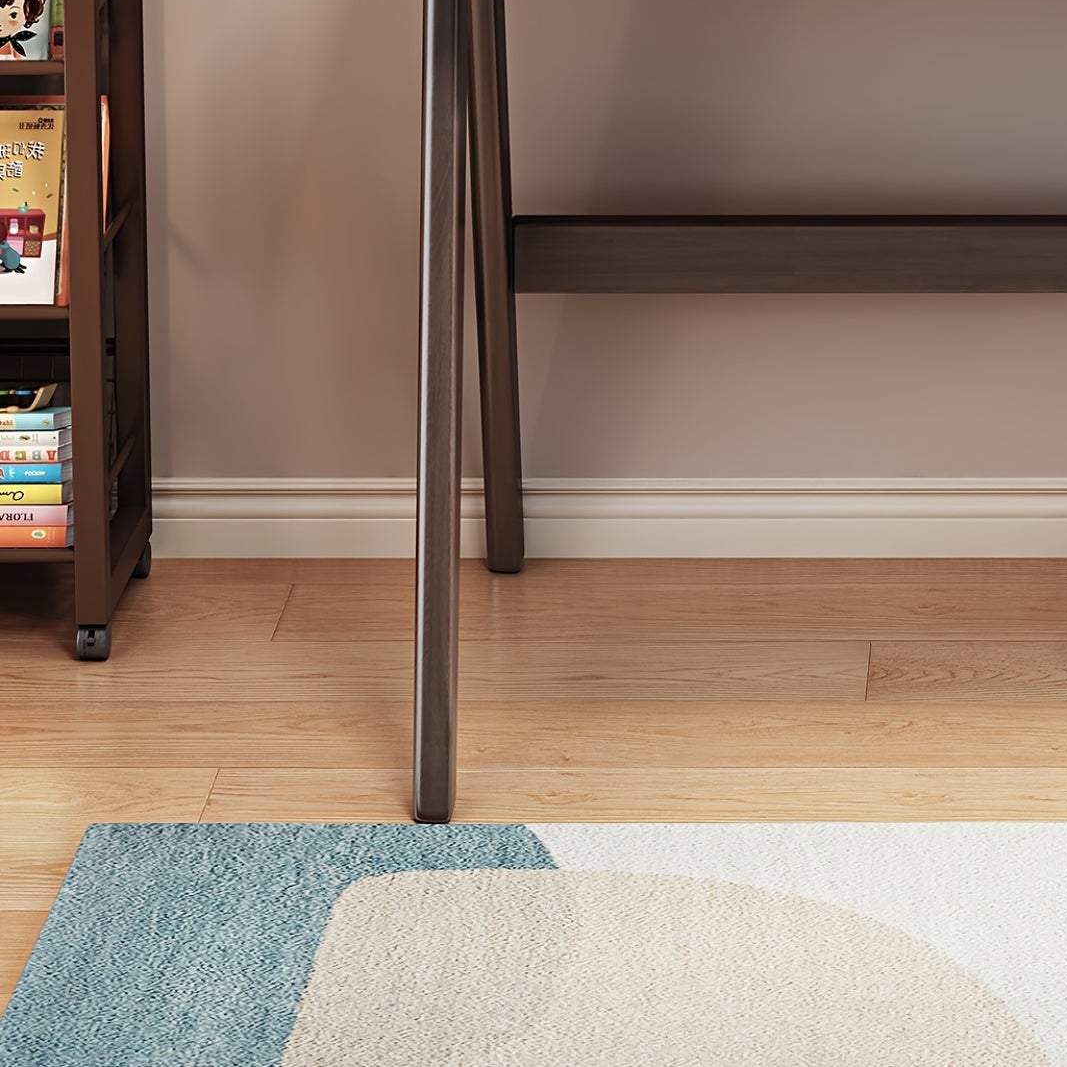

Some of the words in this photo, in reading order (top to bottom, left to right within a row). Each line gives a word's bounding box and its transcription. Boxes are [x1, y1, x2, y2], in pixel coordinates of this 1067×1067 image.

[15, 450, 27, 461] C
[32, 450, 42, 461] B
[46, 450, 57, 461] A
